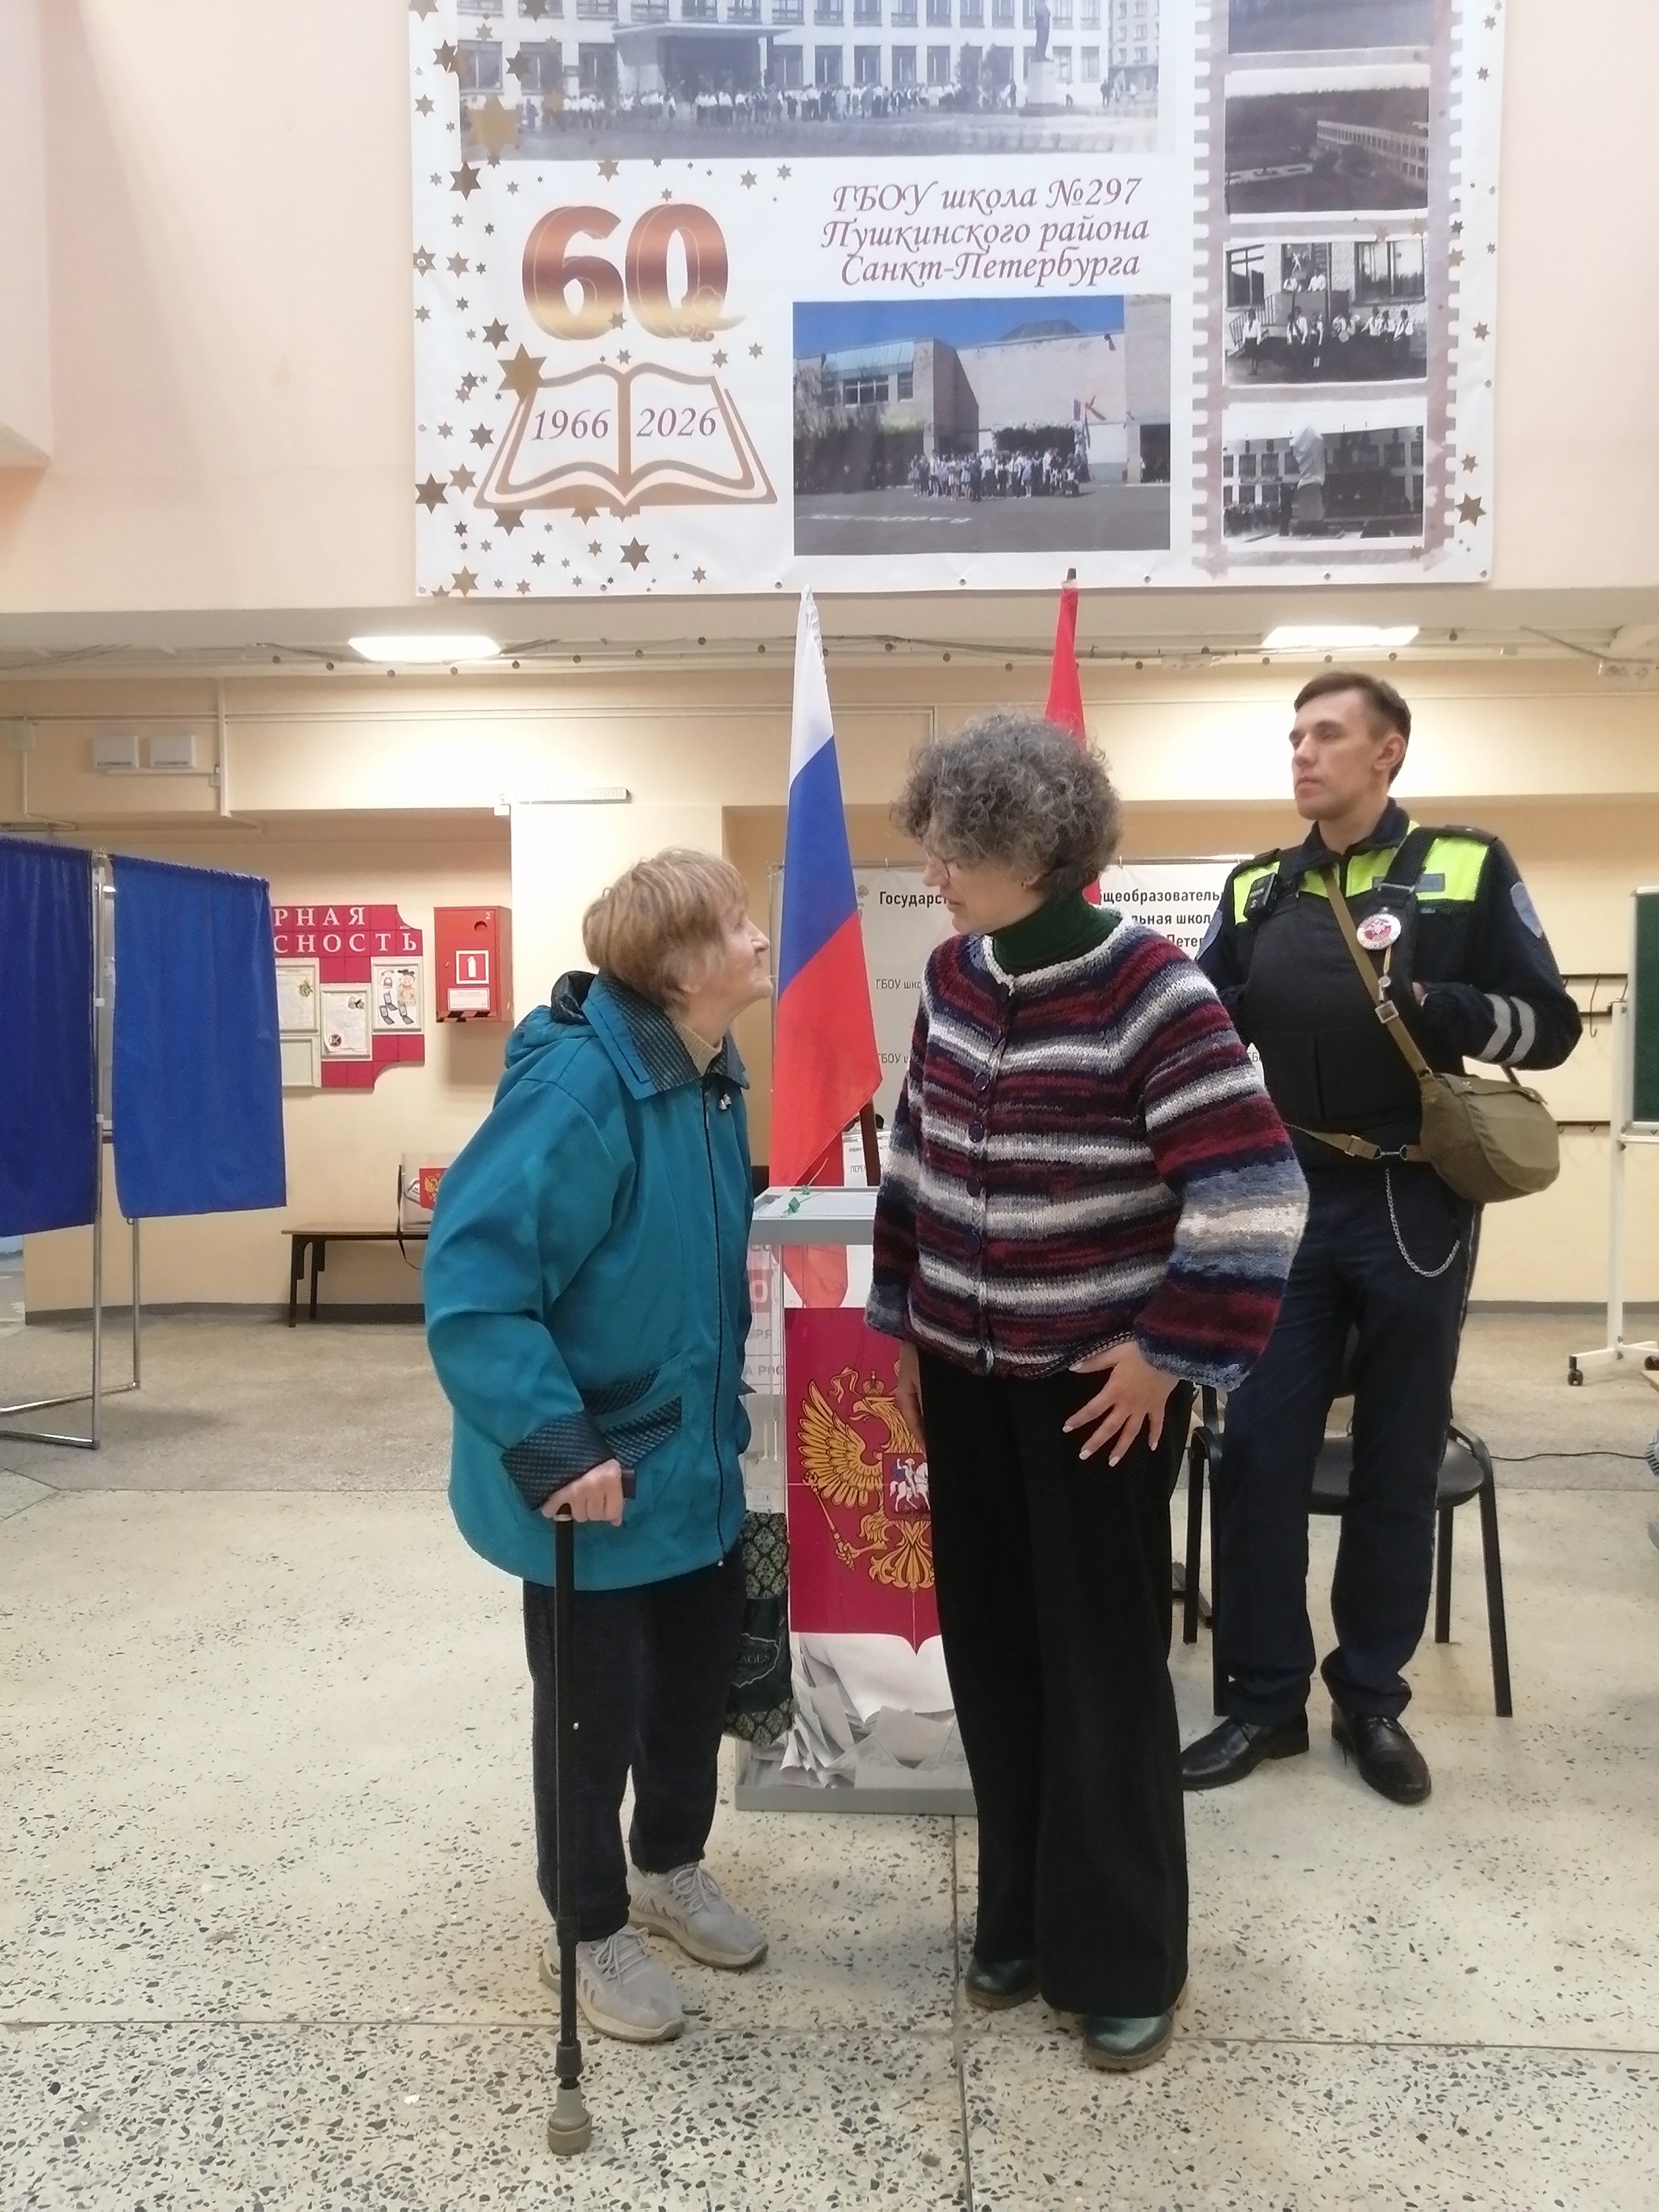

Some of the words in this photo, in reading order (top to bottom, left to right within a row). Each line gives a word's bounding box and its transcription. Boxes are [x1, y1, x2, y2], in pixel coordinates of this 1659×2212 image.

[833, 181, 939, 216] ГБОУ
[942, 187, 1037, 216] школа
[1045, 177, 1143, 208] №297
[821, 217, 1031, 256] Пушкинского
[1037, 215, 1149, 253] района
[522, 203, 730, 342] 60
[842, 246, 1141, 288] Санкт-Петербурга
[531, 409, 612, 441] 1966
[636, 407, 719, 438] 2026
[1103, 889, 1223, 905] щеобразователь
[273, 906, 365, 926] РНАЯ
[1131, 914, 1172, 925] льная
[1176, 914, 1211, 925] школ
[273, 933, 417, 953] СНОСТЬ
[1166, 934, 1204, 948] Пете
[876, 978, 901, 990] ГБОУ
[903, 981, 921, 989] шко
[879, 1052, 901, 1064] БОУ
